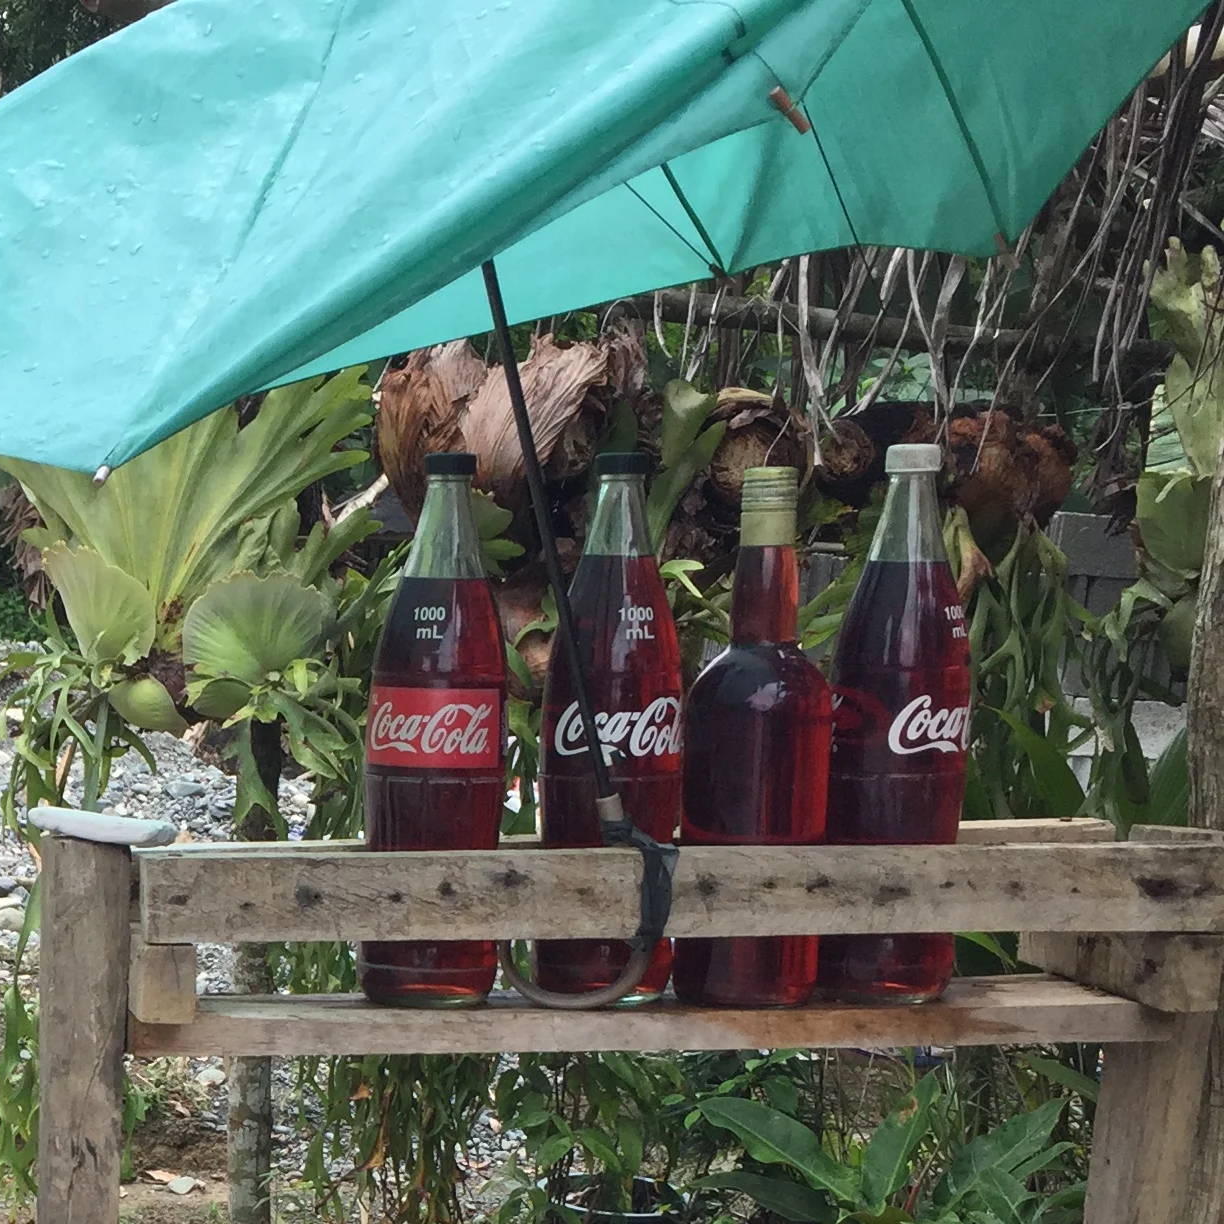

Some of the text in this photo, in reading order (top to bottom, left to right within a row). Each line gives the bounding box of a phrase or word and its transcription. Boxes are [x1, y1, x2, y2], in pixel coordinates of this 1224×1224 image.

[413, 606, 446, 621] 1000
[618, 606, 654, 622] 1000
[416, 624, 443, 639] mL
[625, 625, 655, 640] mL
[370, 701, 493, 755] Coca-Cola
